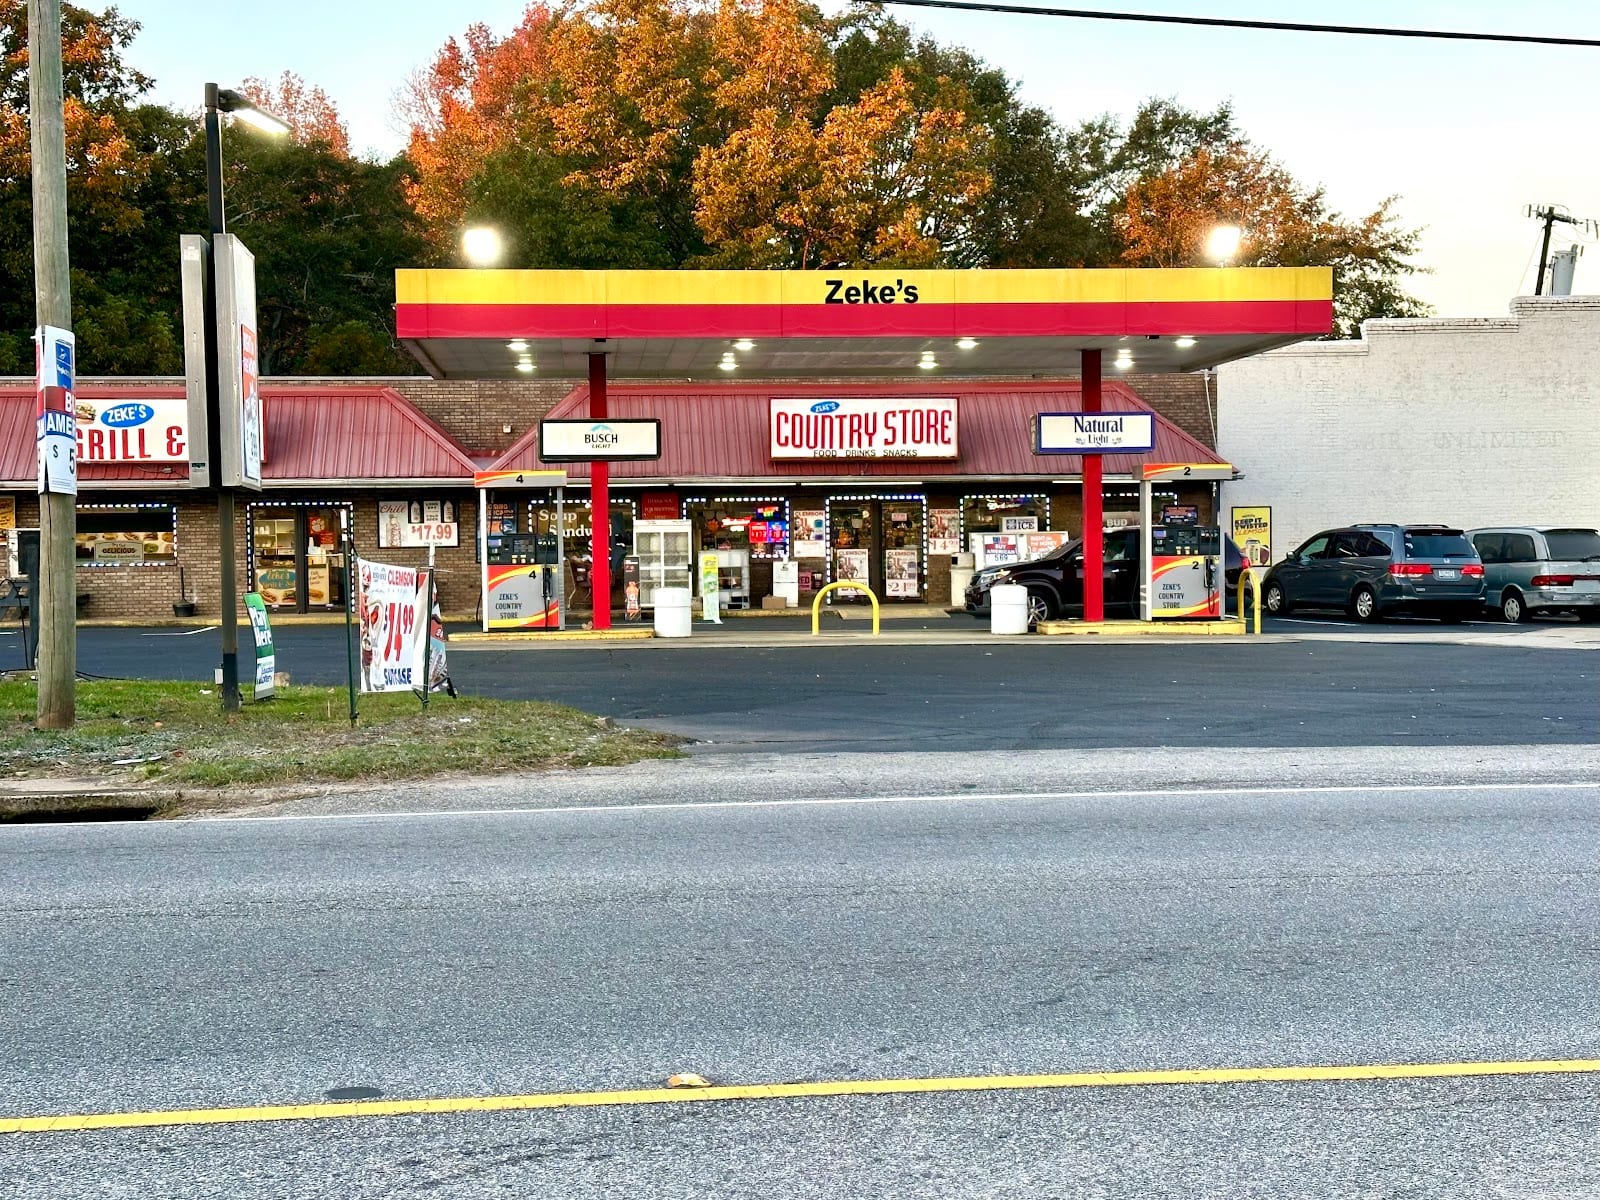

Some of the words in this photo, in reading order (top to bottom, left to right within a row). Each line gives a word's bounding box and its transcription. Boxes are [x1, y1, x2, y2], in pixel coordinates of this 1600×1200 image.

[825, 279, 919, 304] Zeke's
[107, 404, 147, 423] ZEKE'S
[1074, 415, 1124, 433] Natural
[776, 411, 878, 450] COUNTRY
[884, 409, 952, 446] STORE
[166, 425, 186, 457] &
[584, 434, 618, 444] BUSCH
[1088, 434, 1109, 446] Light
[845, 449, 876, 457] DRINKS
[883, 449, 918, 457] SNACKS
[1184, 466, 1191, 475] 2
[516, 474, 524, 484] 4
[1018, 521, 1035, 530] ICE
[1106, 519, 1128, 527] BUD
[411, 524, 452, 541] $17.99
[1192, 561, 1199, 570] 2
[387, 569, 416, 587] CLEMSON
[528, 570, 537, 580] 4
[499, 593, 519, 601] ZEKE'S
[495, 602, 523, 610] COUNTRY
[499, 611, 519, 619] STORE
